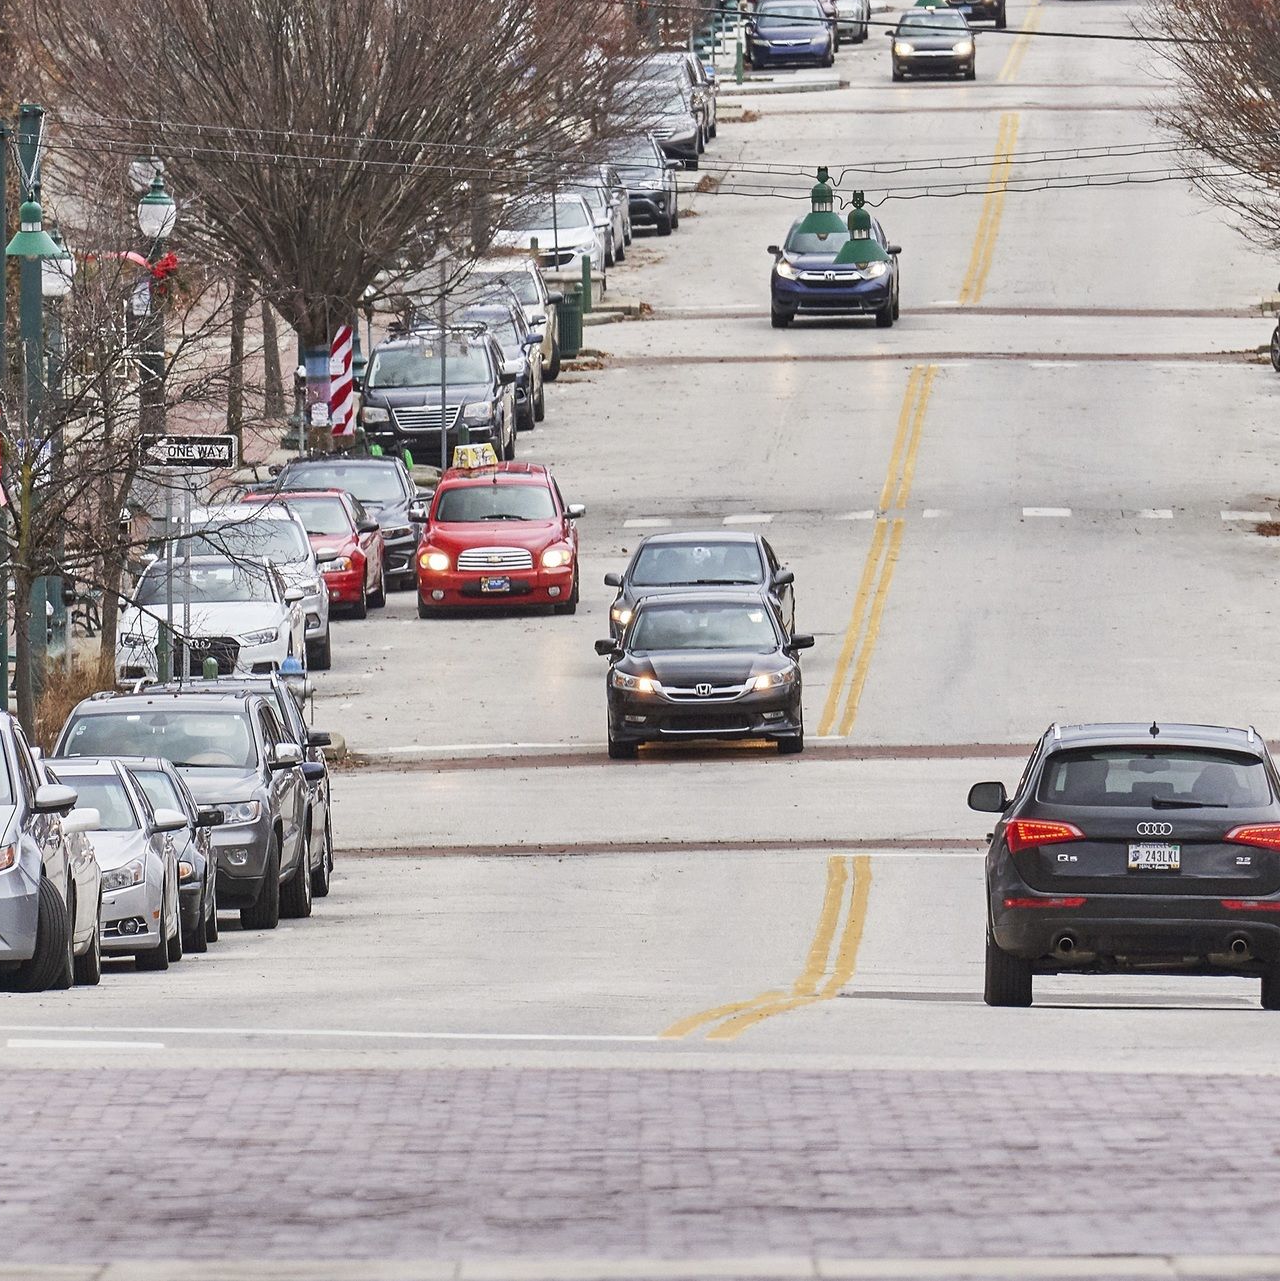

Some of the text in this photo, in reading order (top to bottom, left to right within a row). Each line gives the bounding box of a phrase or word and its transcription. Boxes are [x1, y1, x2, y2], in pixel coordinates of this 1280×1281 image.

[167, 445, 225, 457] ONE WAY
[1057, 854, 1078, 862] Q5
[1145, 850, 1179, 862] 243LKL
